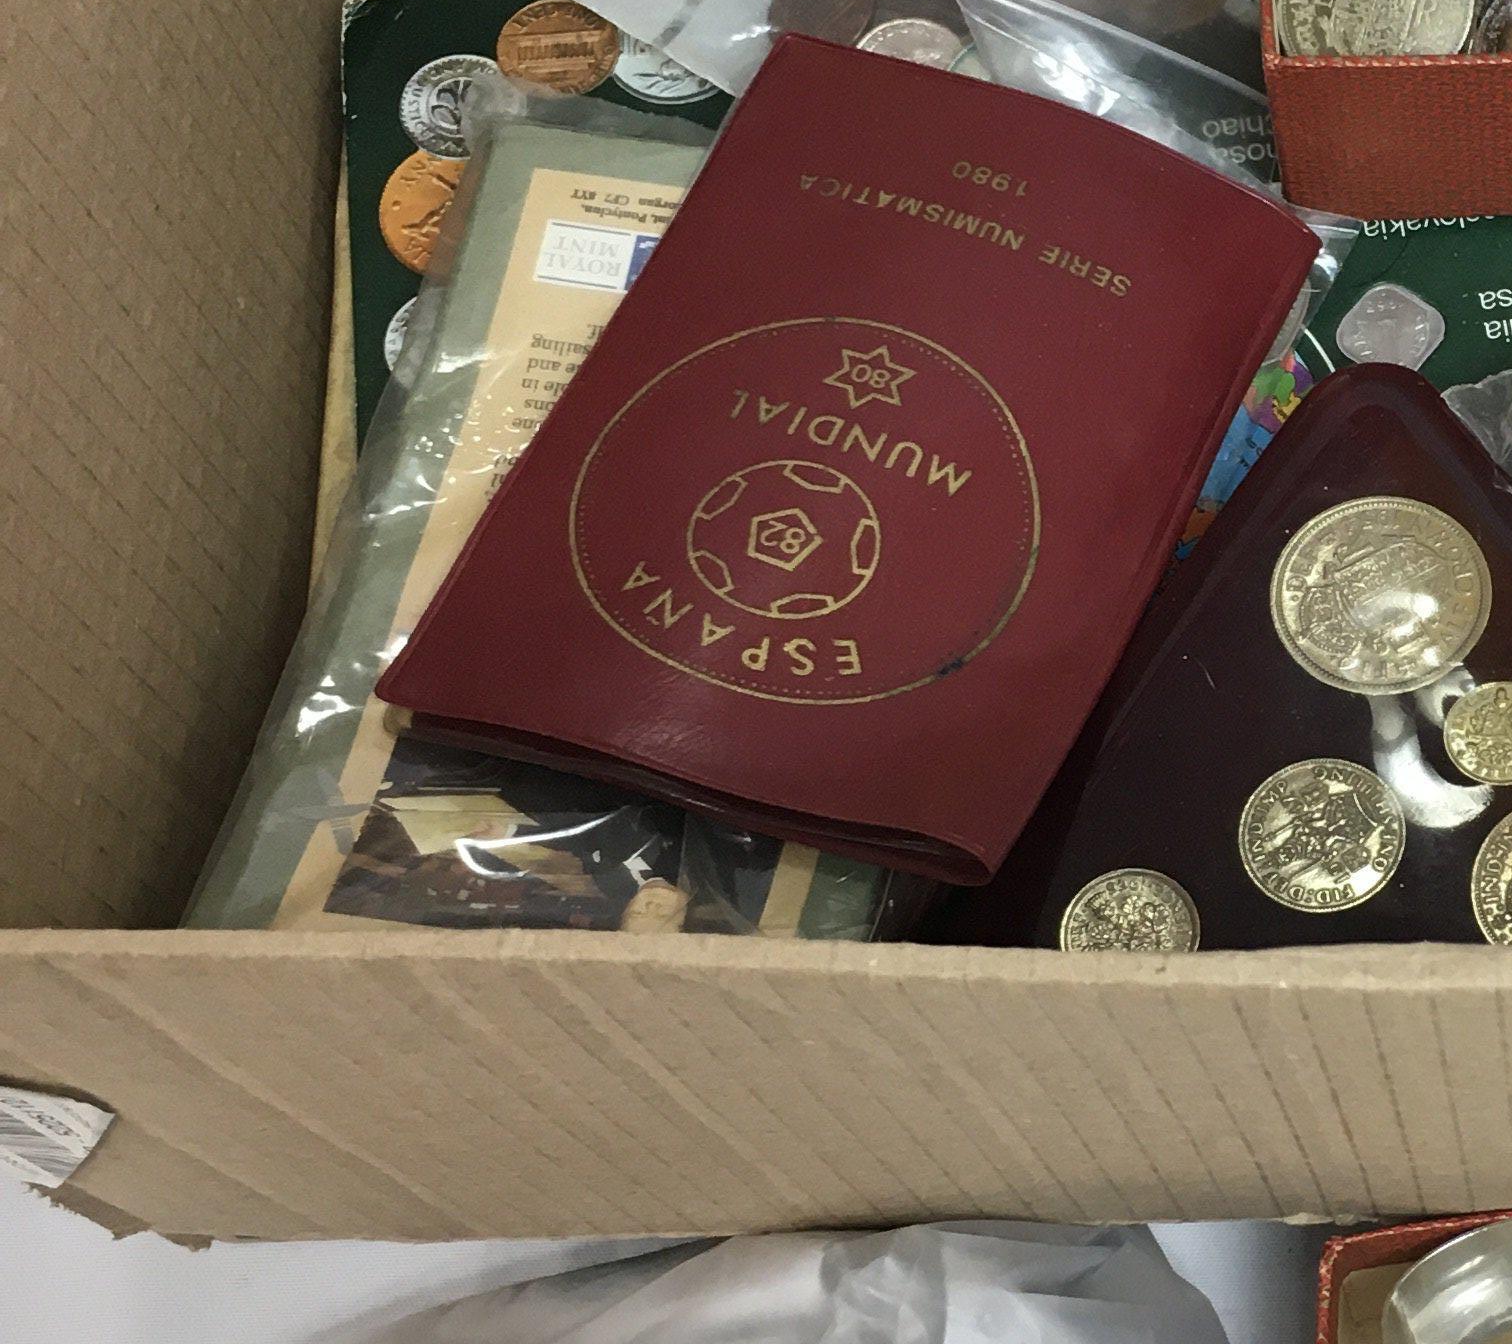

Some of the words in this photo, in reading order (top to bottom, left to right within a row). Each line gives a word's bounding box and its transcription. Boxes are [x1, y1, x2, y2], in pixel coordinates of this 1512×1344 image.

[950, 159, 1030, 200] 1980
[798, 172, 1027, 253] NUMISMATICA
[545, 251, 623, 278] ROYAL
[552, 235, 621, 259] MINT
[1038, 239, 1135, 298] SERIE
[526, 357, 560, 374] and
[850, 362, 889, 391] 80
[520, 376, 540, 391] in
[729, 387, 973, 498] MUNDIAL
[760, 519, 806, 554] 82
[621, 560, 861, 677] ESPAÑA
